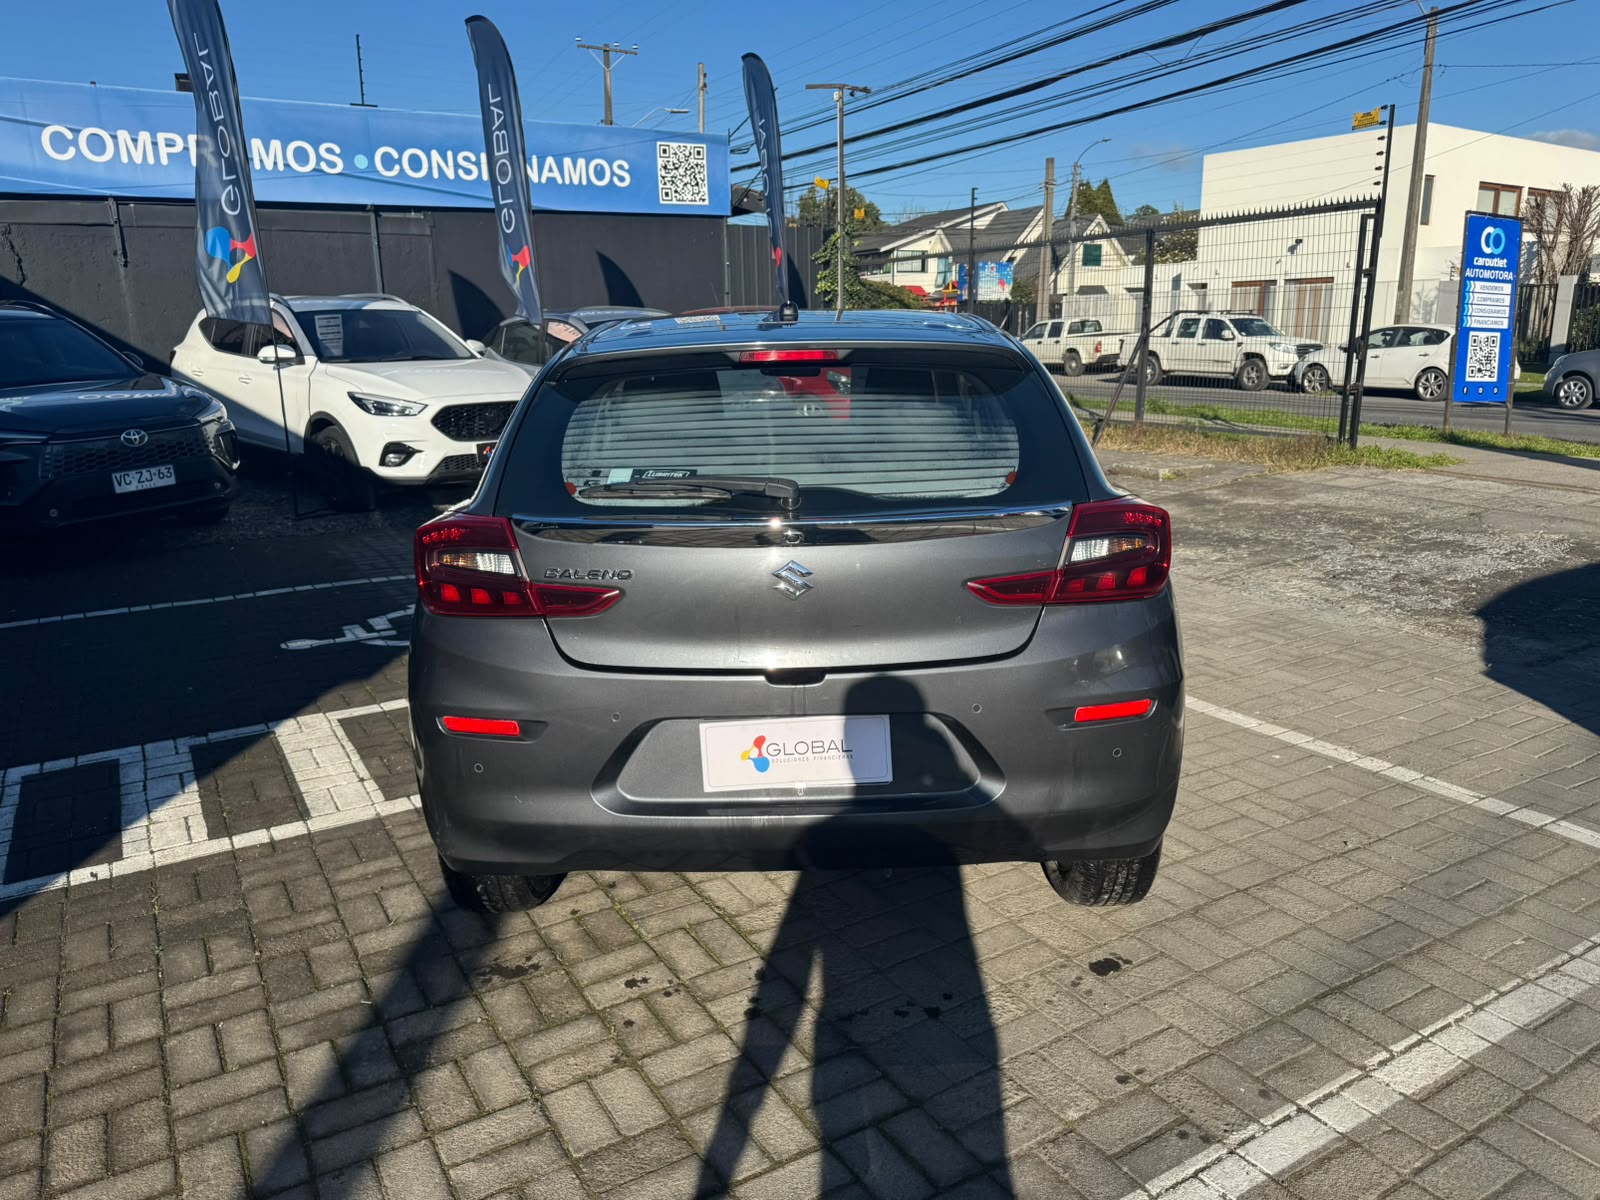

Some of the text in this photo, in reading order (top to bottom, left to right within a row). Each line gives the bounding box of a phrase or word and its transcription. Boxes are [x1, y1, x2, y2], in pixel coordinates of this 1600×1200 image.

[40, 124, 632, 188] COMPRMOS CONSINAMOS
[1474, 257, 1507, 268] caroutlet
[1465, 268, 1514, 280] AUTOMOTORA
[544, 568, 633, 580] BALENO
[766, 739, 853, 757] GLOBAL
